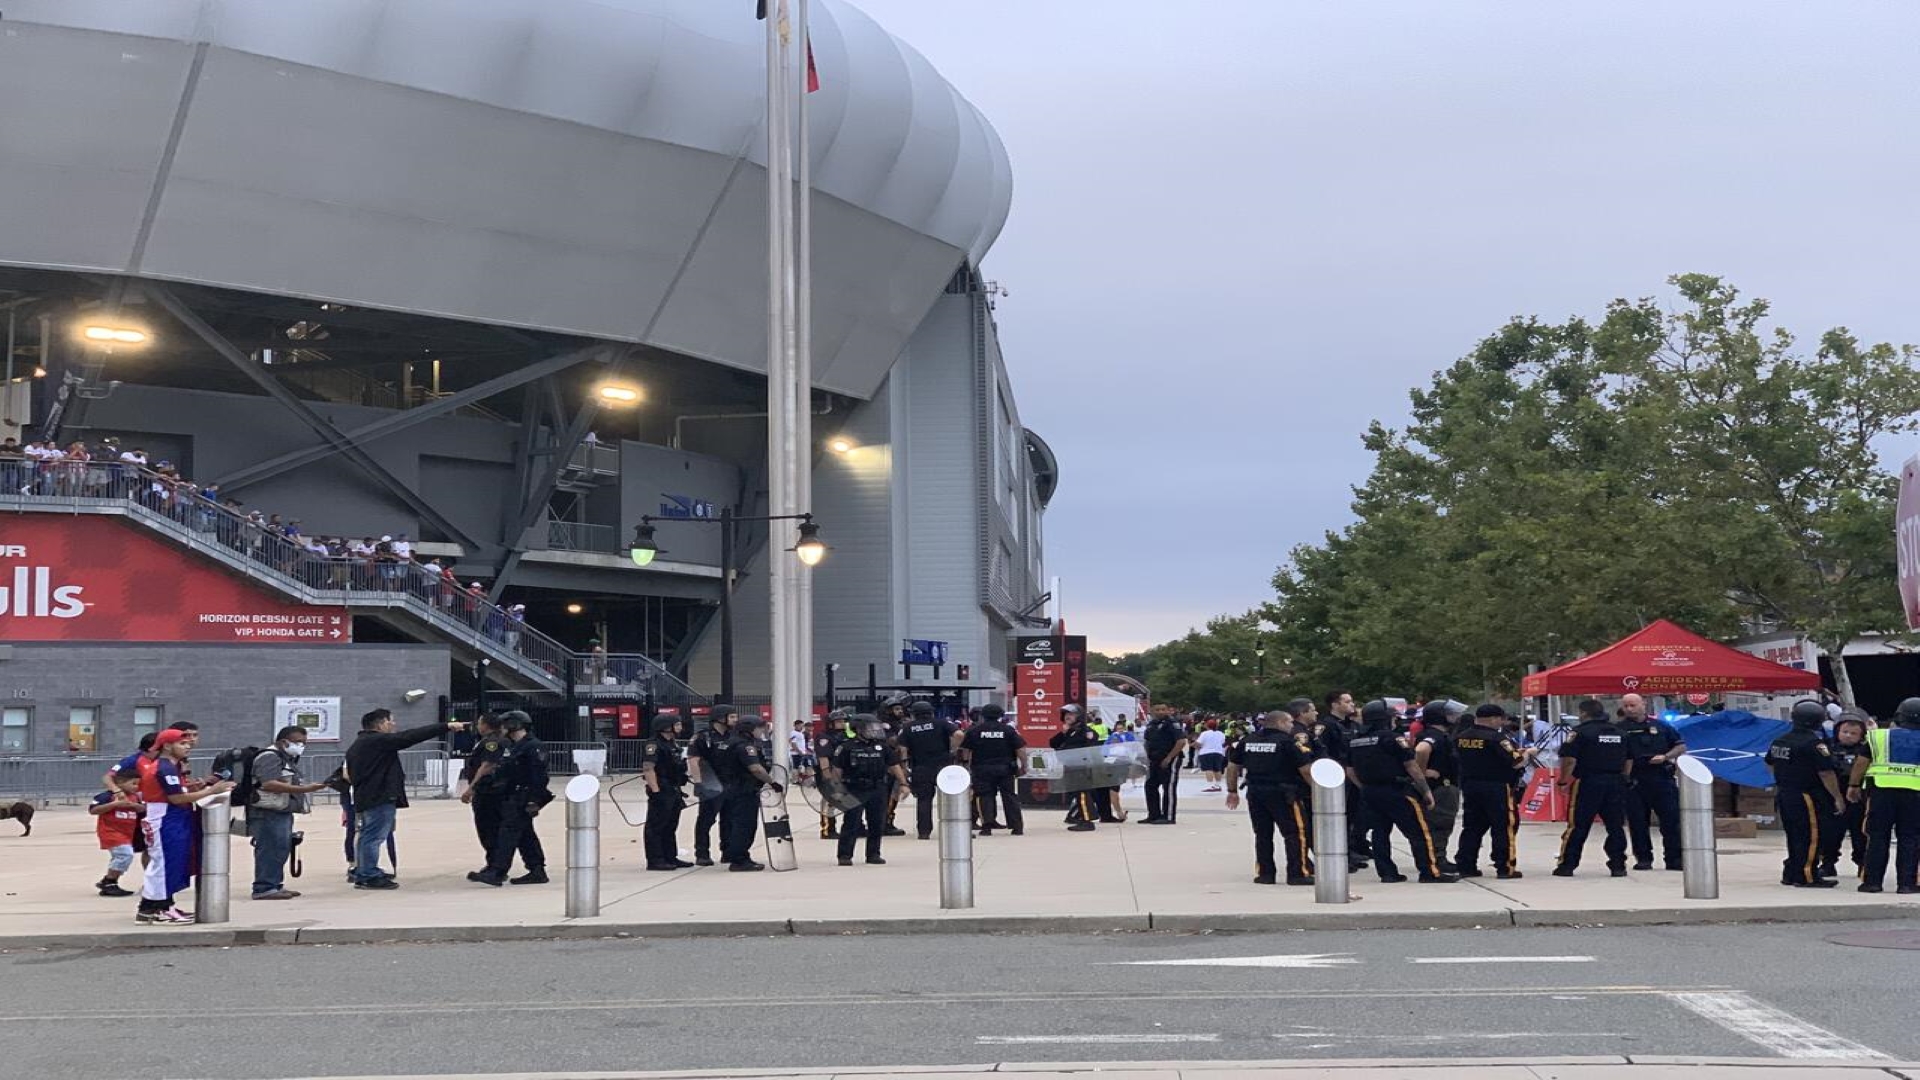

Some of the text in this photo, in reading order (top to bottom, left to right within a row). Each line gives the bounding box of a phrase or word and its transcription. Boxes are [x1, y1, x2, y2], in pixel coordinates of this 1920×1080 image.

[0, 544, 26, 557] R
[0, 566, 85, 618] lls
[200, 614, 324, 624] HORIZON BCBSNJ GATE
[257, 628, 295, 636] HONDA
[297, 628, 324, 637] GATE
[144, 687, 158, 697] 12
[911, 723, 934, 732] POLICE
[1458, 739, 1484, 749] POLICE
